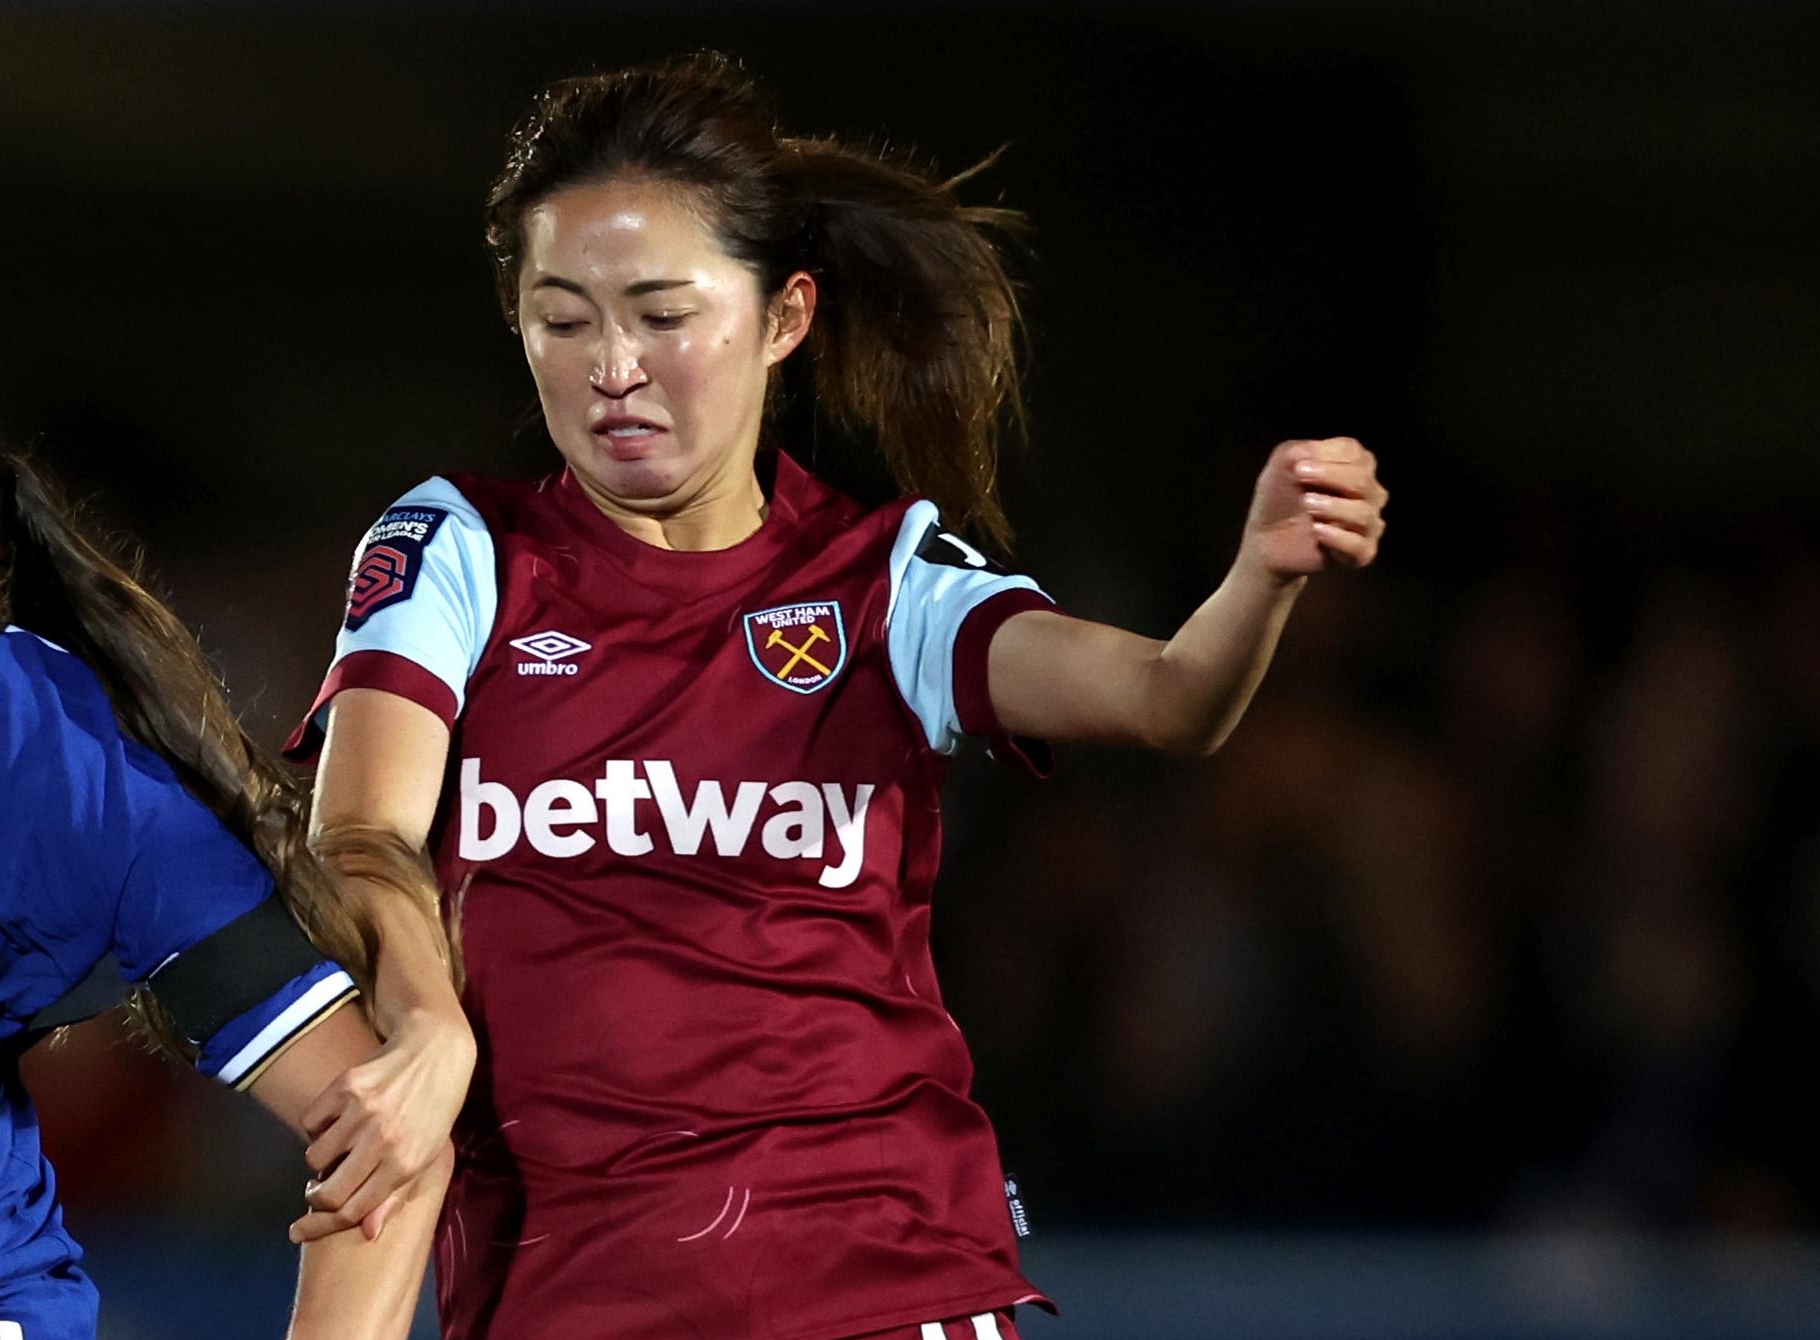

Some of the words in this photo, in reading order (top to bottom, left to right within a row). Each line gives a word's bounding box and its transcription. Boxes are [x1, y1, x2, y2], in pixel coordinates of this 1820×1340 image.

[383, 511, 435, 522] ARCLAYS
[372, 521, 429, 534] OMEN'S
[755, 610, 792, 624] WEST
[794, 606, 830, 617] HAM
[772, 616, 815, 628] UNITED
[517, 660, 578, 675] umbro
[788, 674, 822, 684] LONDON
[458, 757, 875, 888] betway
